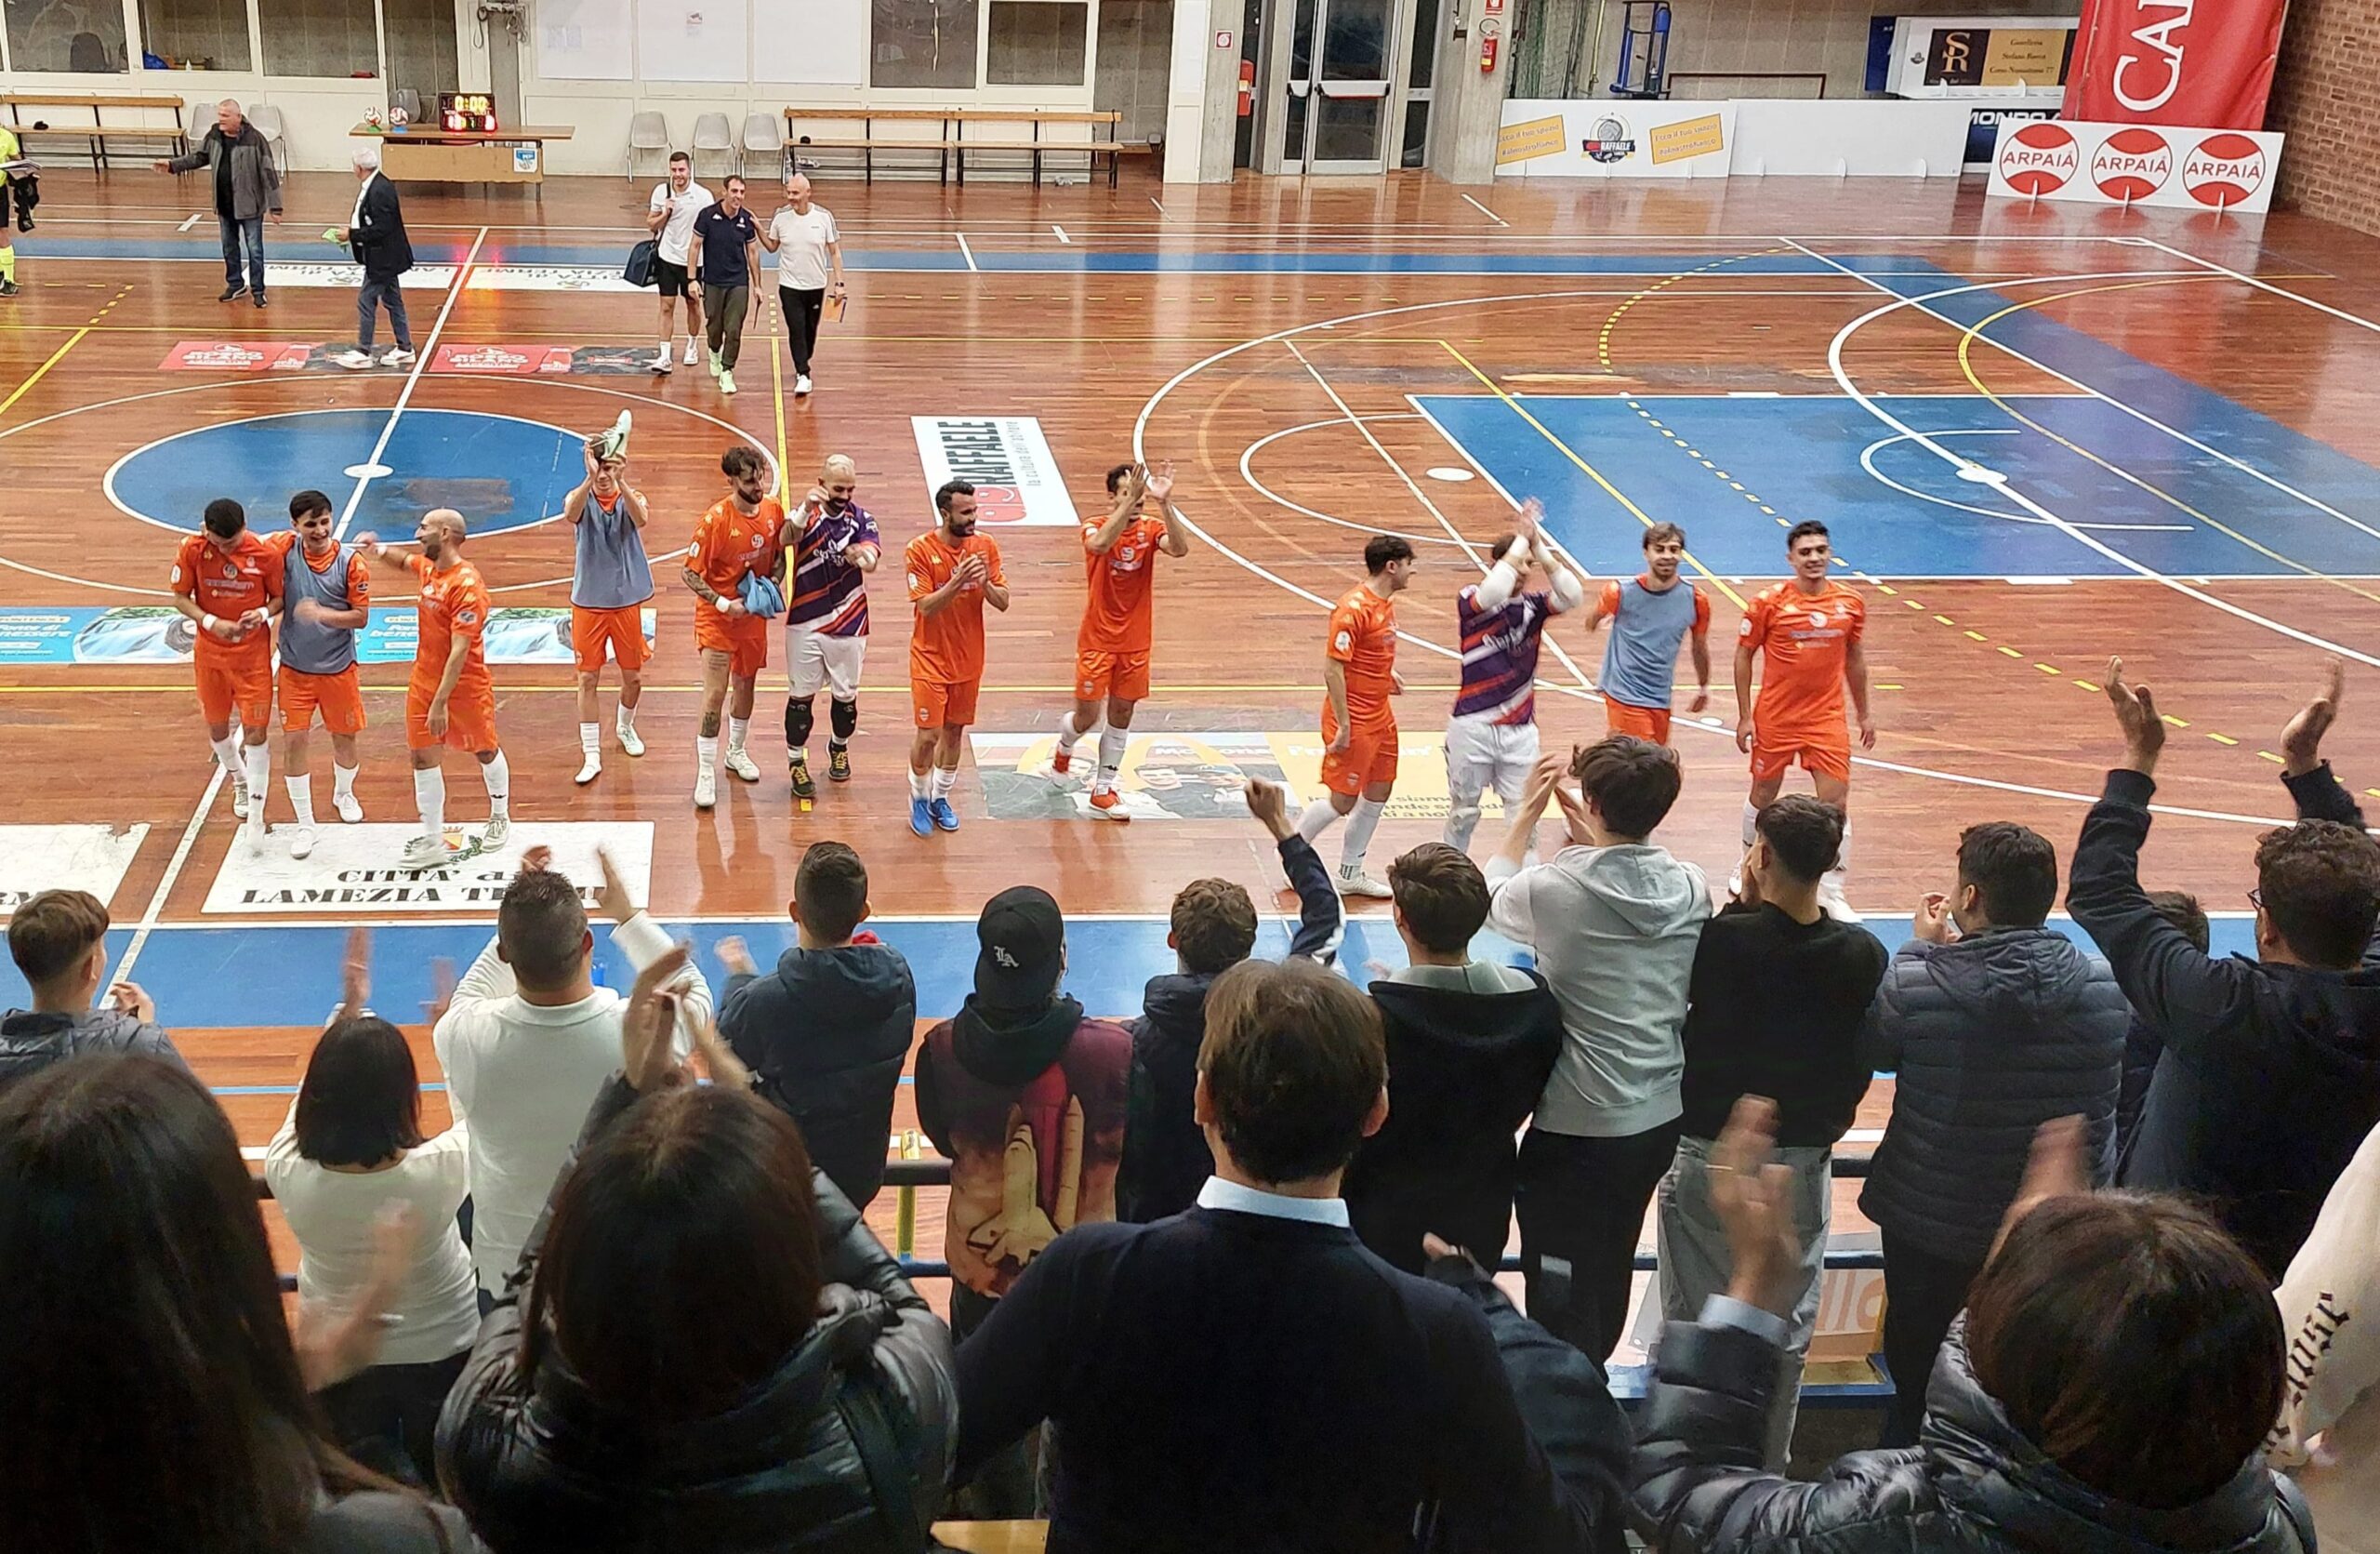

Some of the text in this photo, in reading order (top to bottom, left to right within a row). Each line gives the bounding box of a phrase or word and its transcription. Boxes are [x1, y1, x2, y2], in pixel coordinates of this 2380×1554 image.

[2112, 0, 2194, 111] CA
[937, 421, 1017, 485] RAFFAELE
[240, 888, 441, 904] LAMEZIA
